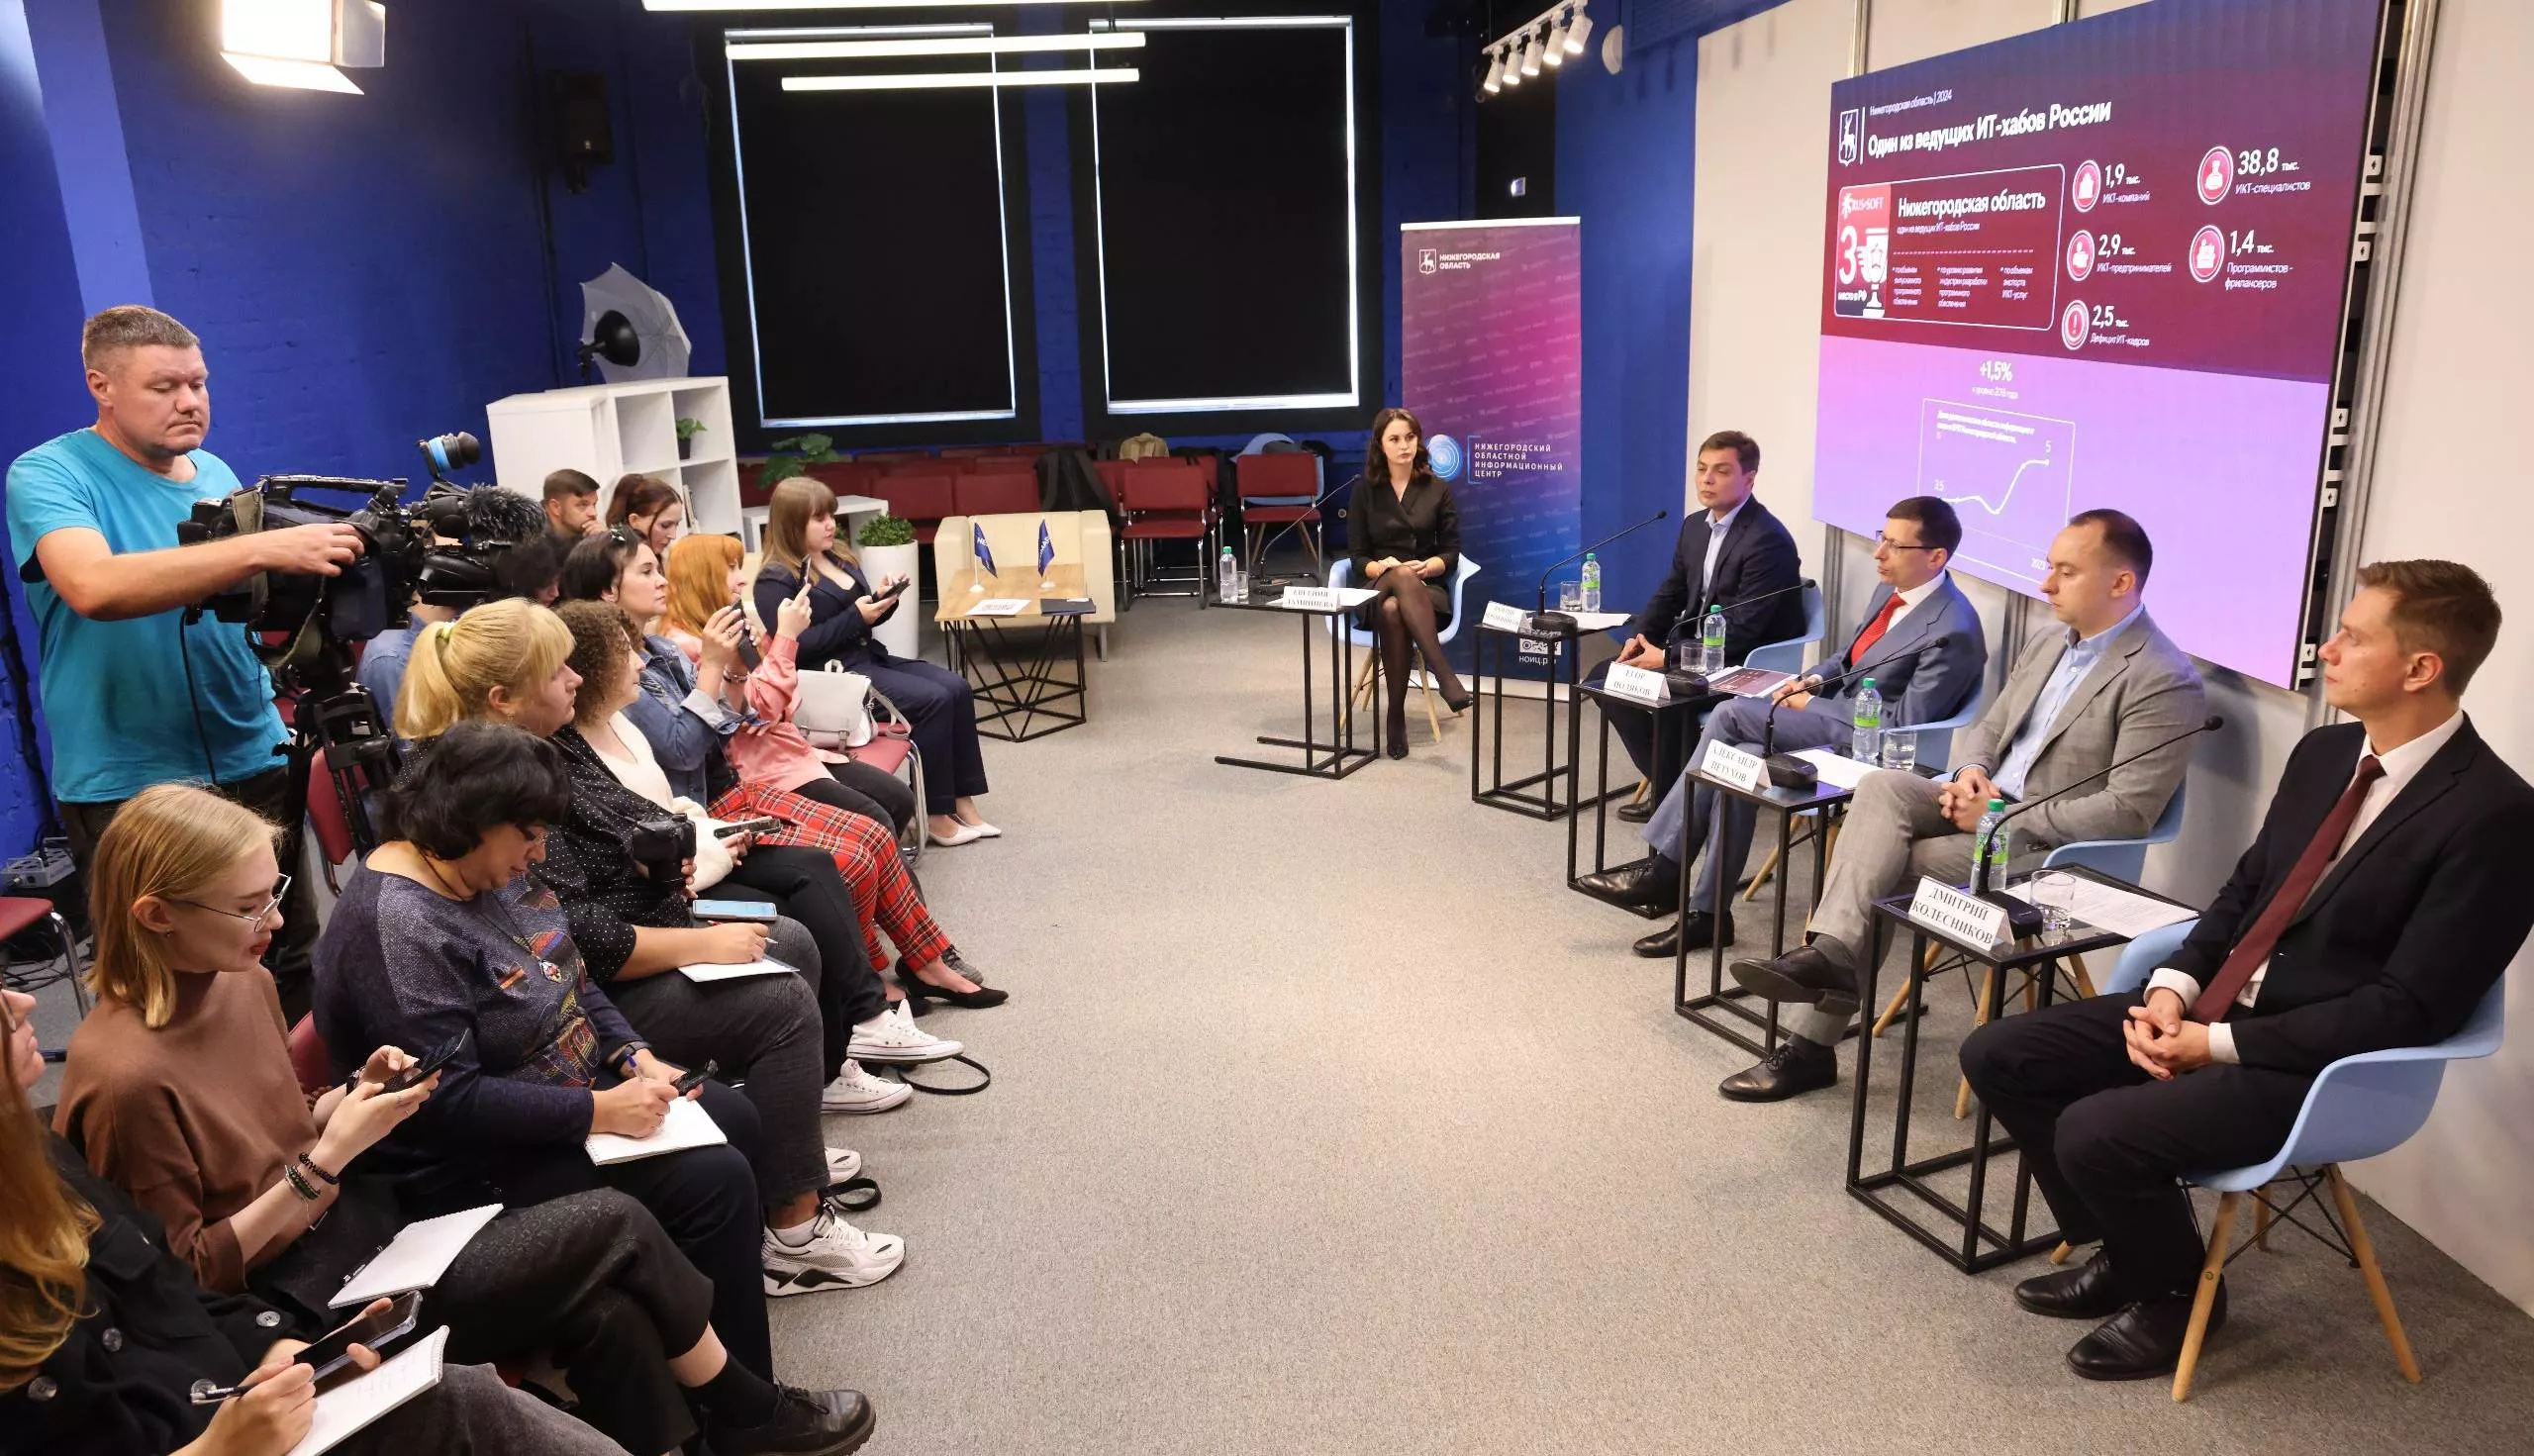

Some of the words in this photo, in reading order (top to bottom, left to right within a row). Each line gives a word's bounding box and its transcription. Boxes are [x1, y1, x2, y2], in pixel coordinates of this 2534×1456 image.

[1868, 135, 1899, 158] Один
[1900, 136, 1913, 151] из
[1914, 123, 1974, 151] ведущих
[1976, 108, 2046, 141] ИТ-хабов
[2048, 102, 2112, 130] России
[2237, 147, 2280, 176] 38,8
[2104, 163, 2125, 188] 1,9
[2234, 181, 2311, 194] ИКТ-специалистов
[1898, 195, 1989, 220] Нижегородская
[1991, 189, 2046, 210] область
[1838, 225, 1858, 285] 3
[2097, 234, 2121, 257] 2,9
[2230, 230, 2255, 256] 1,4
[1439, 252, 1501, 262] НИЖЕГОРОДСКАЯ
[1439, 261, 1471, 270] ОБЛАСТЬ
[2091, 304, 2115, 329] 2,5
[1474, 442, 1552, 452] НИЖЕГОРОДСКИЙ
[1474, 451, 1527, 461] ОБЛАСТНОЙ
[1474, 460, 1564, 471] ИНФОРМАЦИОННЫЙ
[1518, 655, 1557, 666] ноиц.р
[1928, 887, 1989, 921] ДМИТРИЙ
[1912, 901, 1994, 944] КОЛЕСНИКОВ
